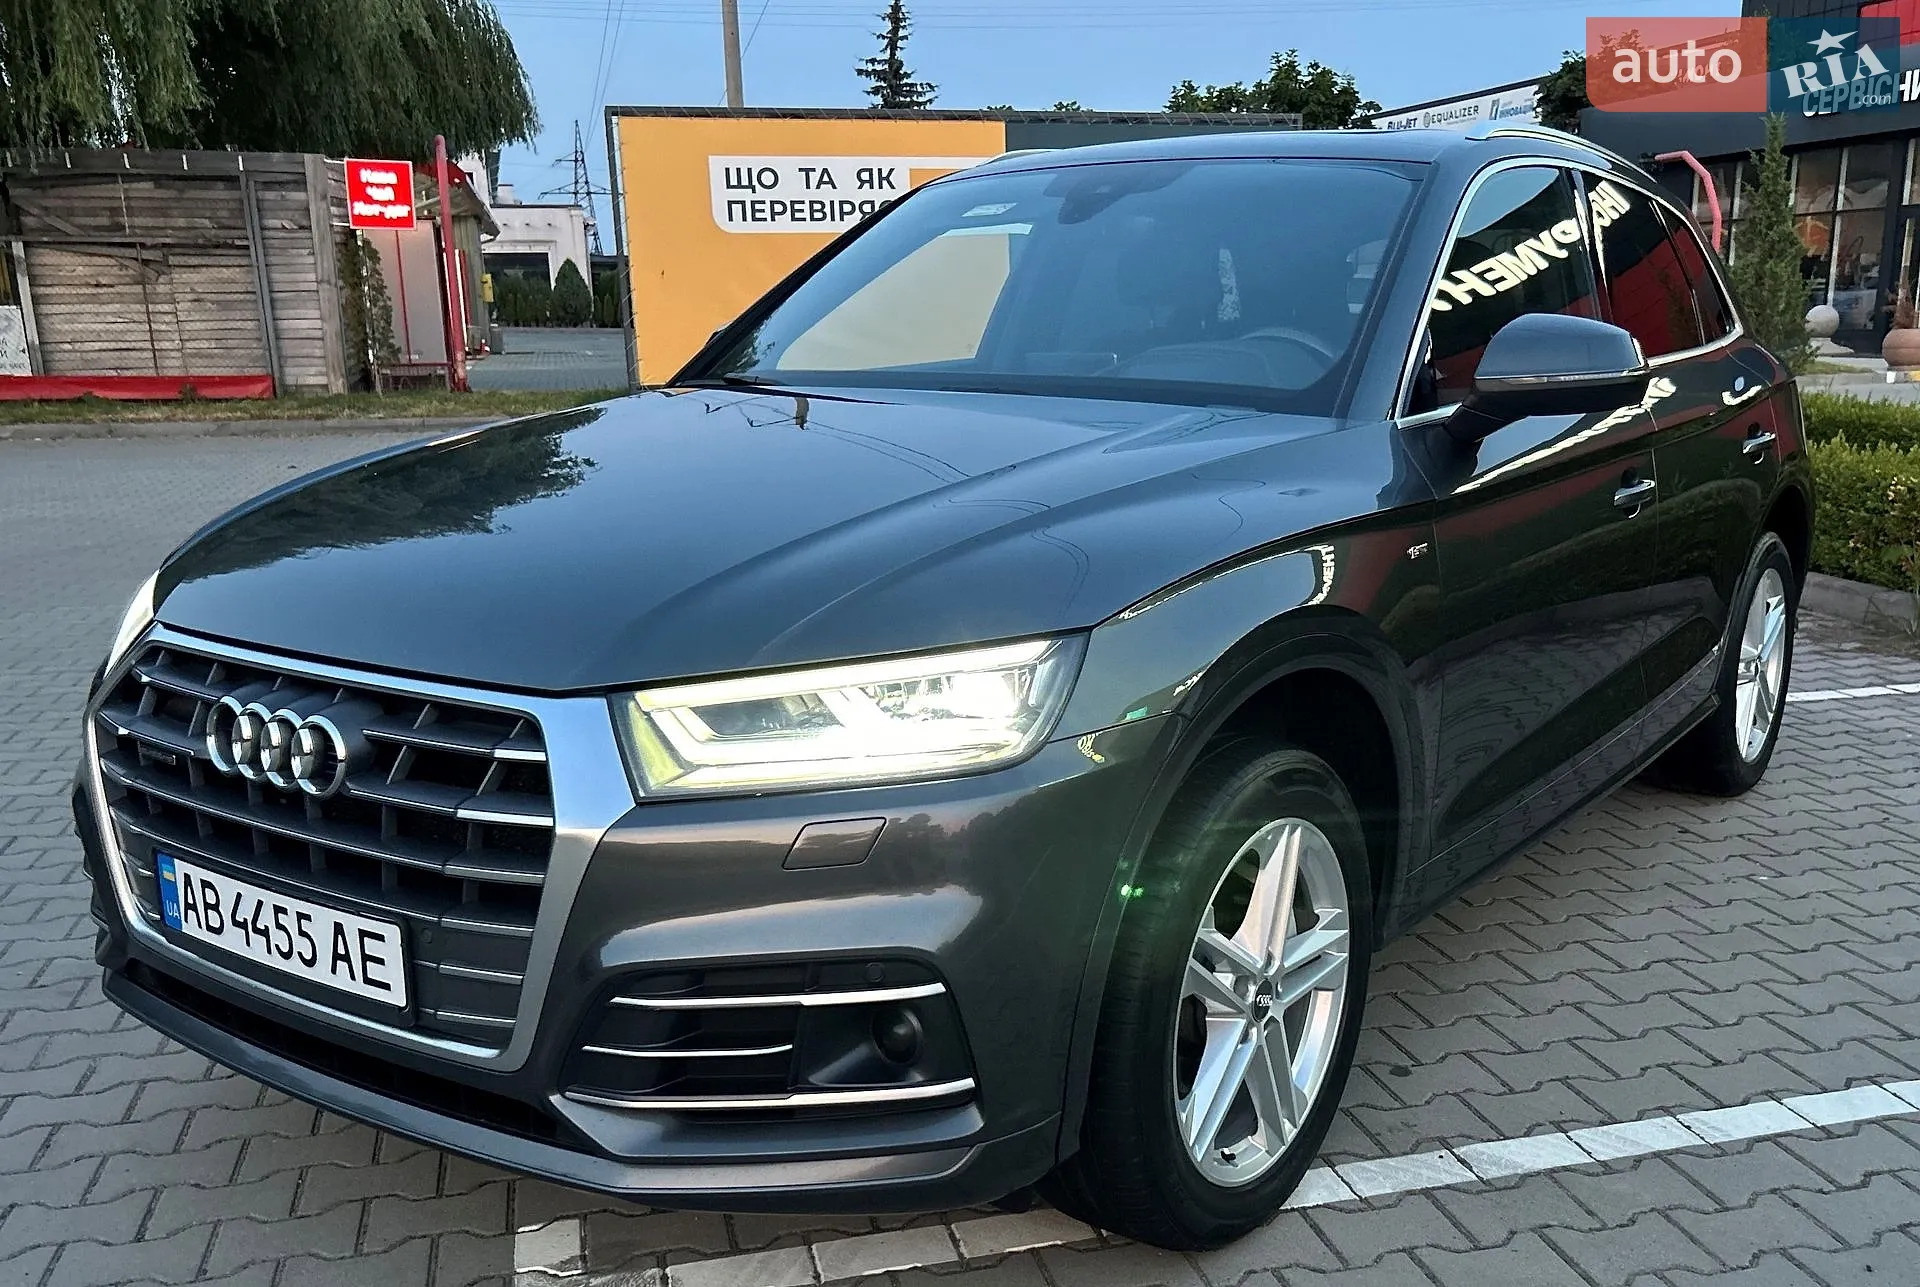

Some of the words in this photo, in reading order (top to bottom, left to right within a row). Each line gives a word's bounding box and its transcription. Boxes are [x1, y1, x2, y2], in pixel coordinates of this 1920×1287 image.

[1431, 105, 1480, 123] EQUALIZER
[724, 167, 779, 194] ЩО
[798, 167, 837, 190] ТА
[856, 167, 896, 190] ЯК
[166, 904, 181, 920] UA
[183, 872, 225, 935] AB
[231, 891, 318, 968] 4455
[331, 921, 392, 992] AE
